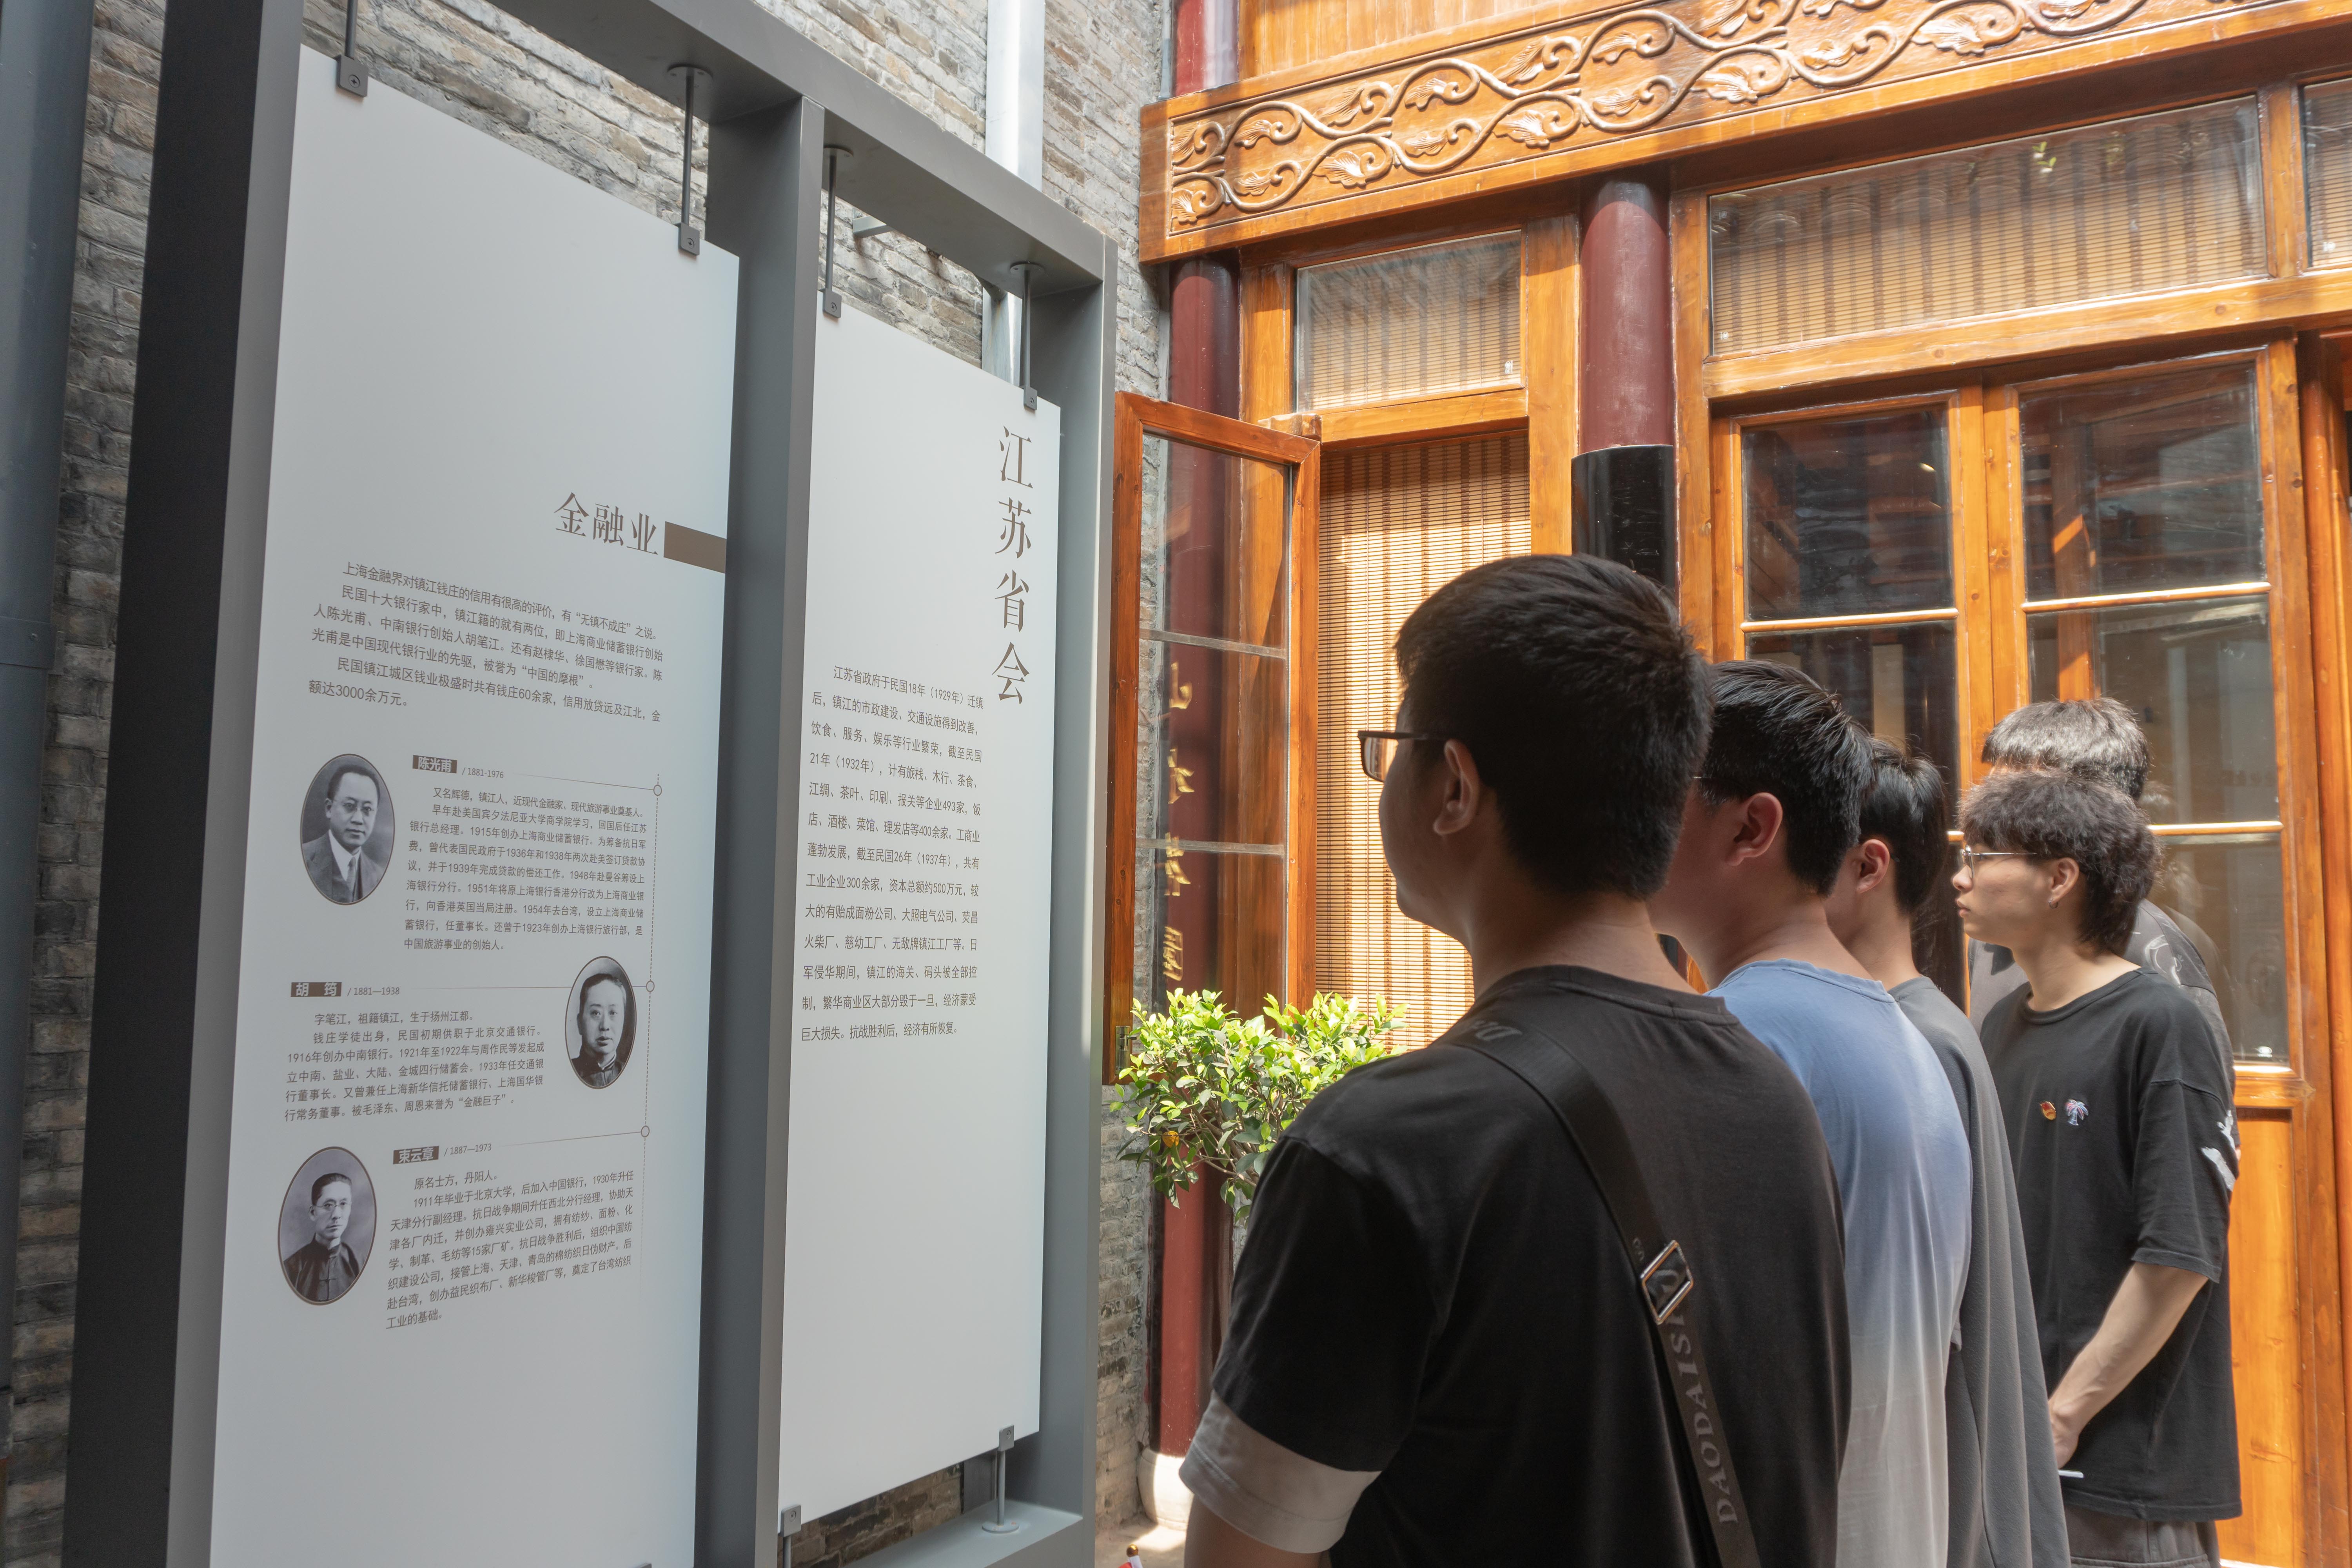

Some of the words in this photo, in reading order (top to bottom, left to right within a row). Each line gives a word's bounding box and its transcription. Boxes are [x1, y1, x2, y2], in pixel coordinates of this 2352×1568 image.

[554, 492, 658, 555] 金融业
[992, 426, 1033, 704] 江苏省会
[309, 679, 407, 706] 额达3000余万元。
[812, 691, 977, 735] 后，镇江的市政建设、交通设施得到改善，
[811, 720, 982, 762] 饮食、服务、娱乐等行业繁荣，截至民国
[418, 756, 452, 773] 陈光甫
[404, 938, 504, 950] 中国旅游事业的创始人。
[803, 965, 977, 980] 军侵华期间，镇江的海关、码头被全部控
[314, 1011, 473, 1025] 字笔江，祖籍镇江，生于扬州江都。
[802, 1021, 957, 1041] 巨大损失。抗战胜利后，经济有所恢复。
[398, 1147, 434, 1164] 束云章
[414, 1170, 497, 1190] 原名士方，丹阳人。
[386, 1308, 442, 1329] 工业的基础。
